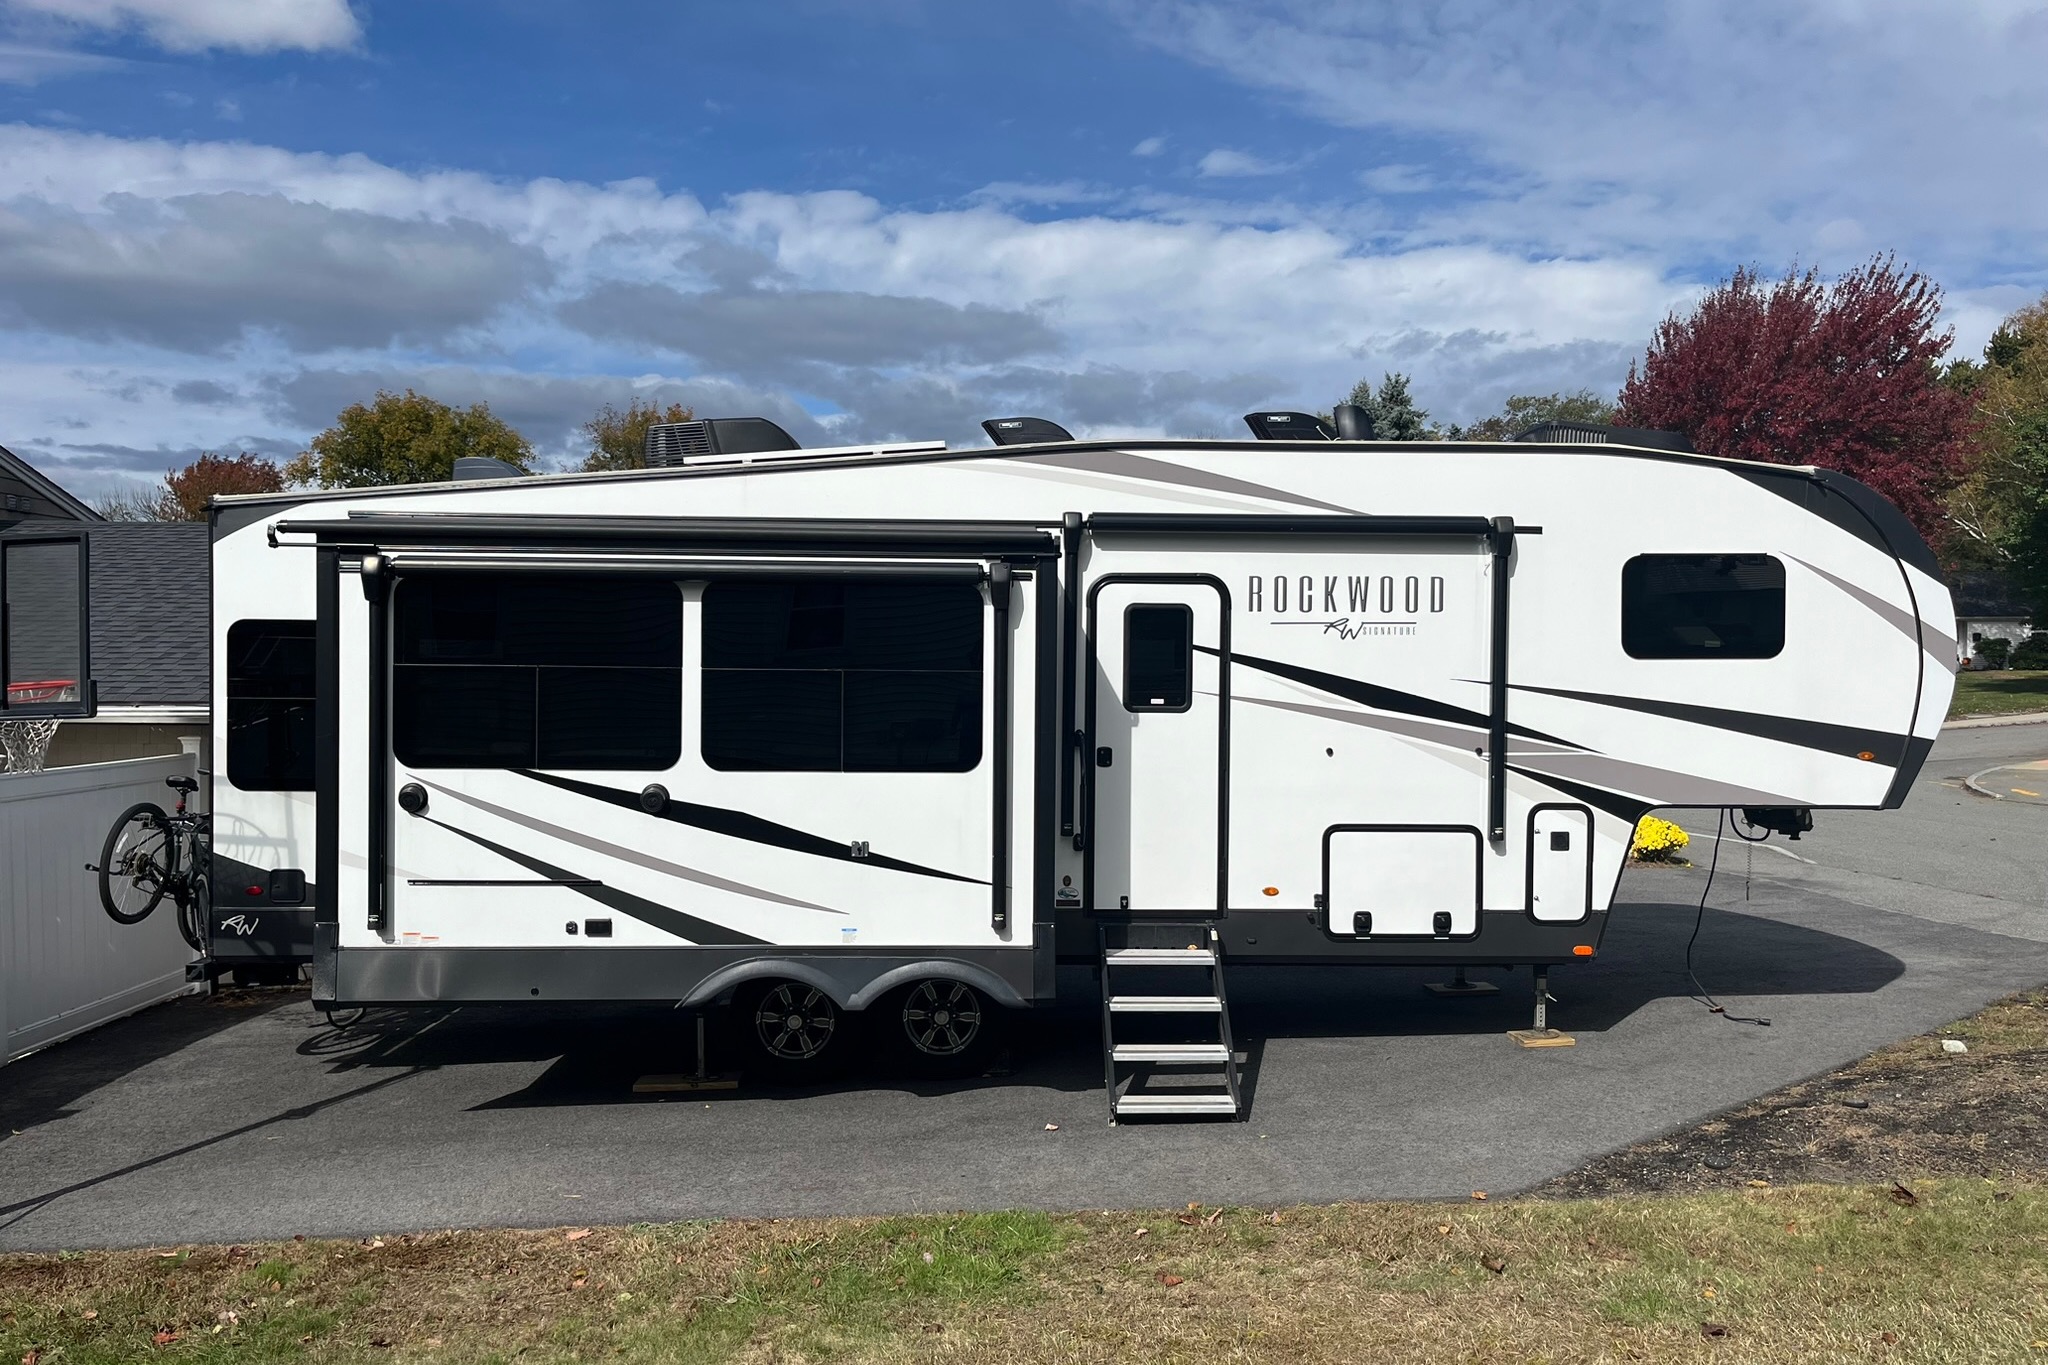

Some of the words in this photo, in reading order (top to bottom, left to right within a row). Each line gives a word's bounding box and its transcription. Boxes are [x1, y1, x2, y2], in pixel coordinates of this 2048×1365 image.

[1248, 575, 1444, 613] ROCKWOOD
[1362, 626, 1416, 636] SIGNATURE
[220, 914, 259, 936] RW
